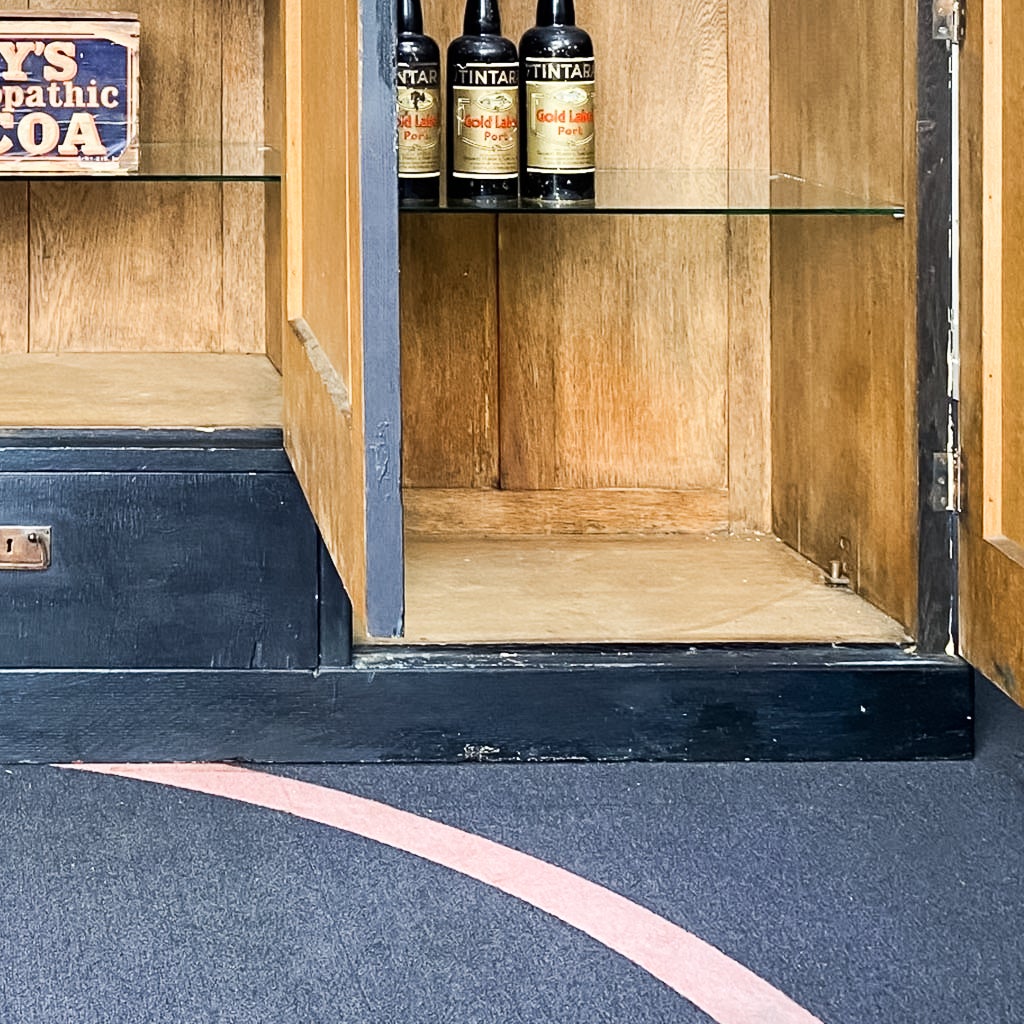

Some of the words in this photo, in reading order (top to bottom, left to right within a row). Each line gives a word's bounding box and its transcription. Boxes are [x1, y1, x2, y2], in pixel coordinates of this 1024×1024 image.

[464, 114, 492, 128] Gold
[536, 108, 565, 123] Gold
[558, 125, 584, 136] Port
